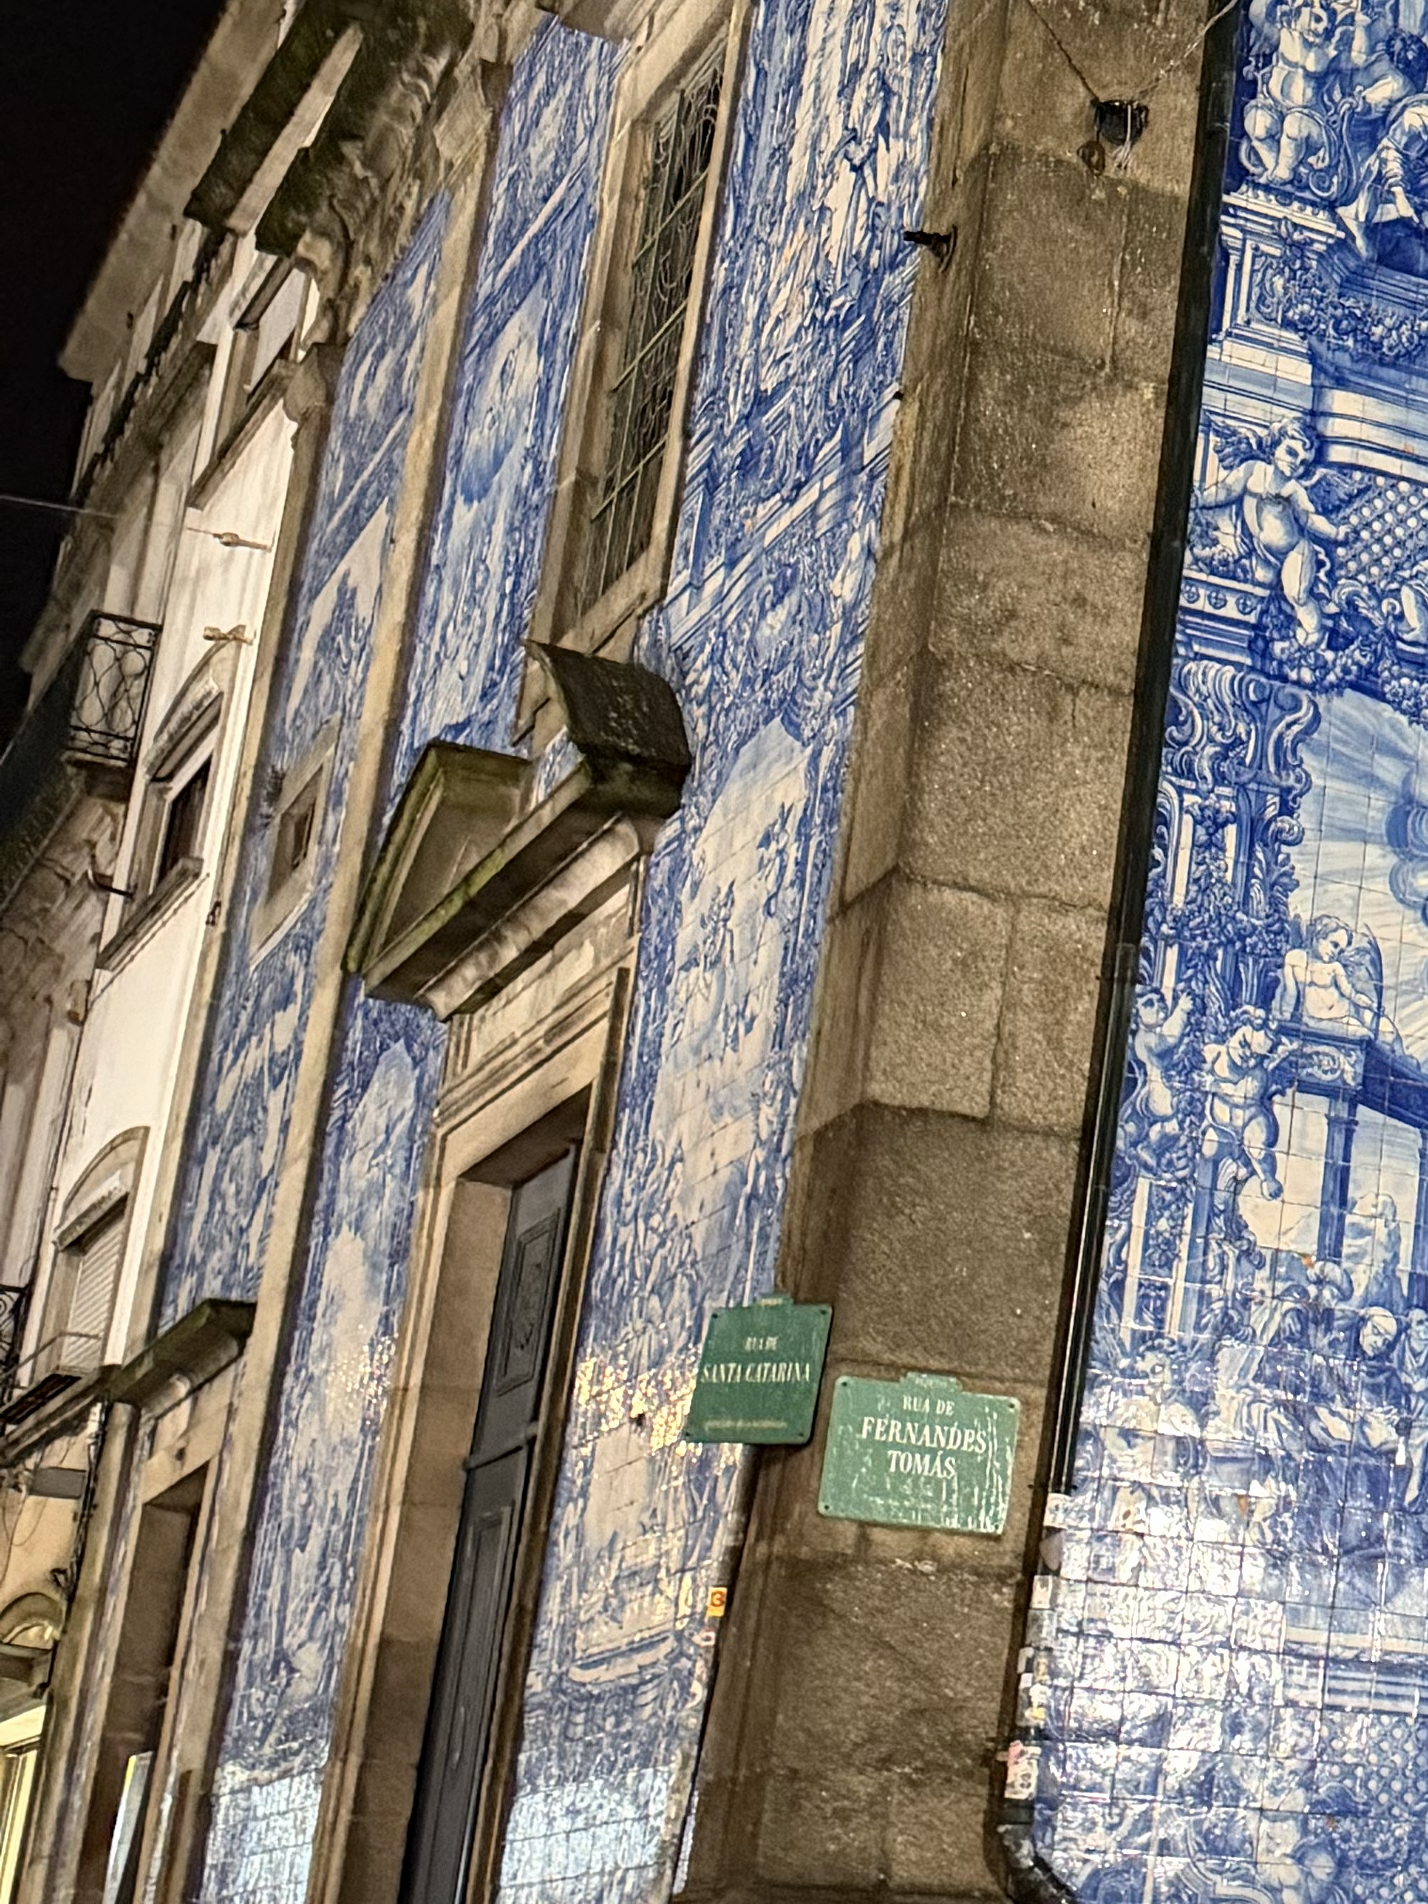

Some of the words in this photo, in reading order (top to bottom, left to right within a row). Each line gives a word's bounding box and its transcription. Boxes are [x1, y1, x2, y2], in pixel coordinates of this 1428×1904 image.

[744, 1336, 764, 1352] RUA
[765, 1336, 779, 1351] DE
[701, 1361, 742, 1383] SANTA
[744, 1361, 811, 1383] CATARINA
[902, 1395, 930, 1413] RUA
[935, 1399, 955, 1416] DE
[861, 1416, 987, 1454] FERNANDES
[887, 1450, 957, 1479] TOMÁS
